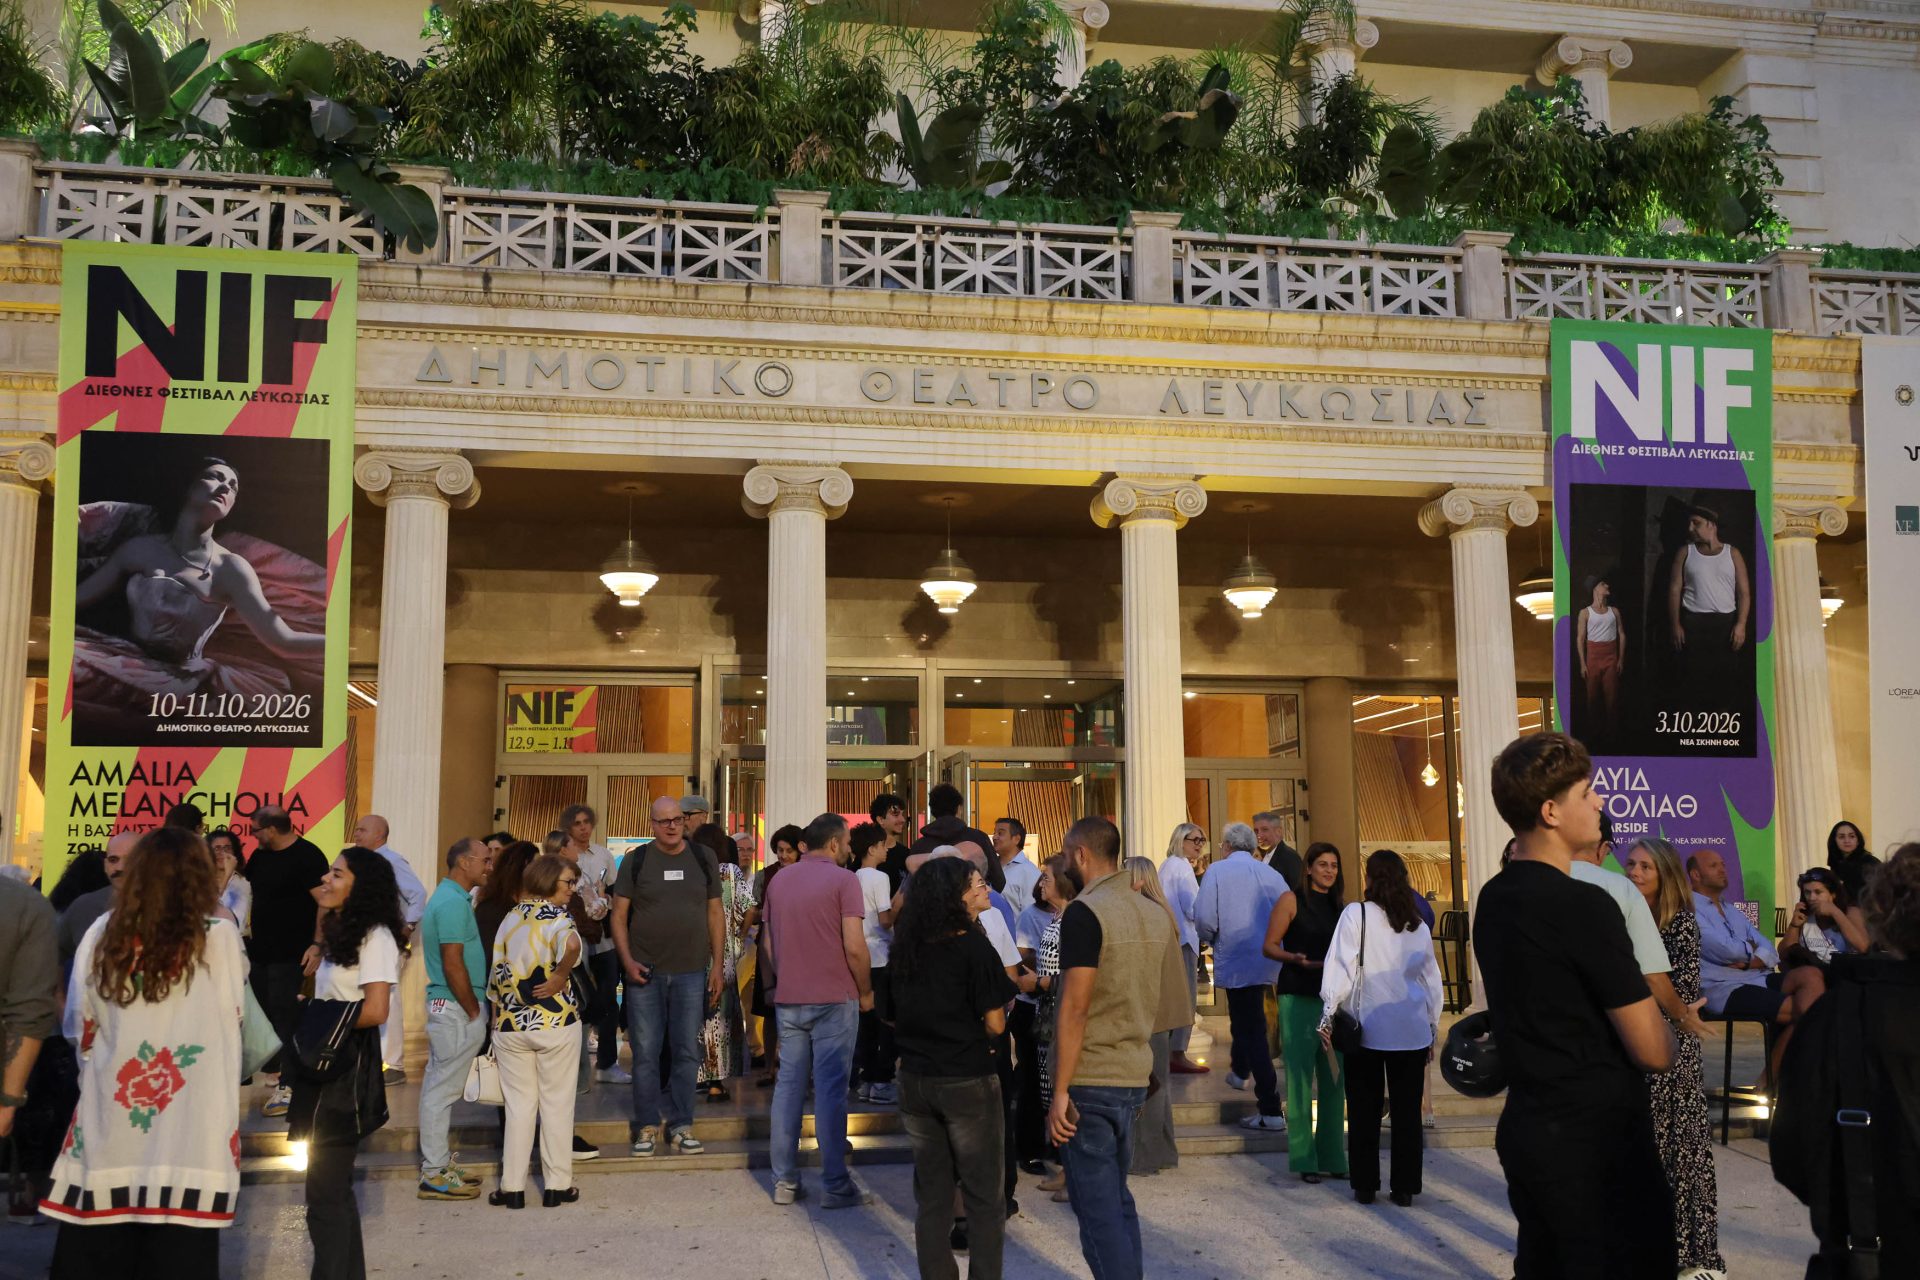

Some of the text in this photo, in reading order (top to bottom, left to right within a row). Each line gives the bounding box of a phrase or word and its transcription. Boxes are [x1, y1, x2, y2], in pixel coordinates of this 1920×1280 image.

[85, 264, 332, 385] NIF
[85, 384, 330, 405] ΔΙΕΘΝΕΣ ΦΕΣΤΙΒΑΛ ΛΕΥΚΩΣΙΑΣ
[415, 345, 1488, 426] ΔΗΜΟΤΙΚΟ ΘΕΑΤΡΟ ΛΕΥΚΩΣΙΑΣ
[1570, 340, 1754, 444] NIF
[1571, 444, 1755, 461] ΔΙΕΘΝΕΣ ΦΕΣΤΙΒΑΛ ΛΕΥΚΩΣΙΑΣ
[147, 692, 312, 719] 10-11.10.2026
[508, 691, 575, 725] NIF
[156, 724, 310, 733] ΔΗΜΟΤΙΚΟ ΘΕΑΤΡΟ ΛΕΥΚΩΣΙΑΣ
[1655, 711, 1741, 734] 3.10.2026
[508, 736, 535, 750] 12.9
[1680, 738, 1695, 746] ΝΕΑ
[1696, 738, 1722, 746] ΣΚΗΝΗ
[69, 760, 198, 787] AMALIA
[1591, 766, 1650, 791] ΑΥΙΔ
[68, 823, 79, 837] Η
[1674, 837, 1690, 845] NEA
[1690, 837, 1708, 845] SKINI
[1708, 837, 1726, 845] THOC
